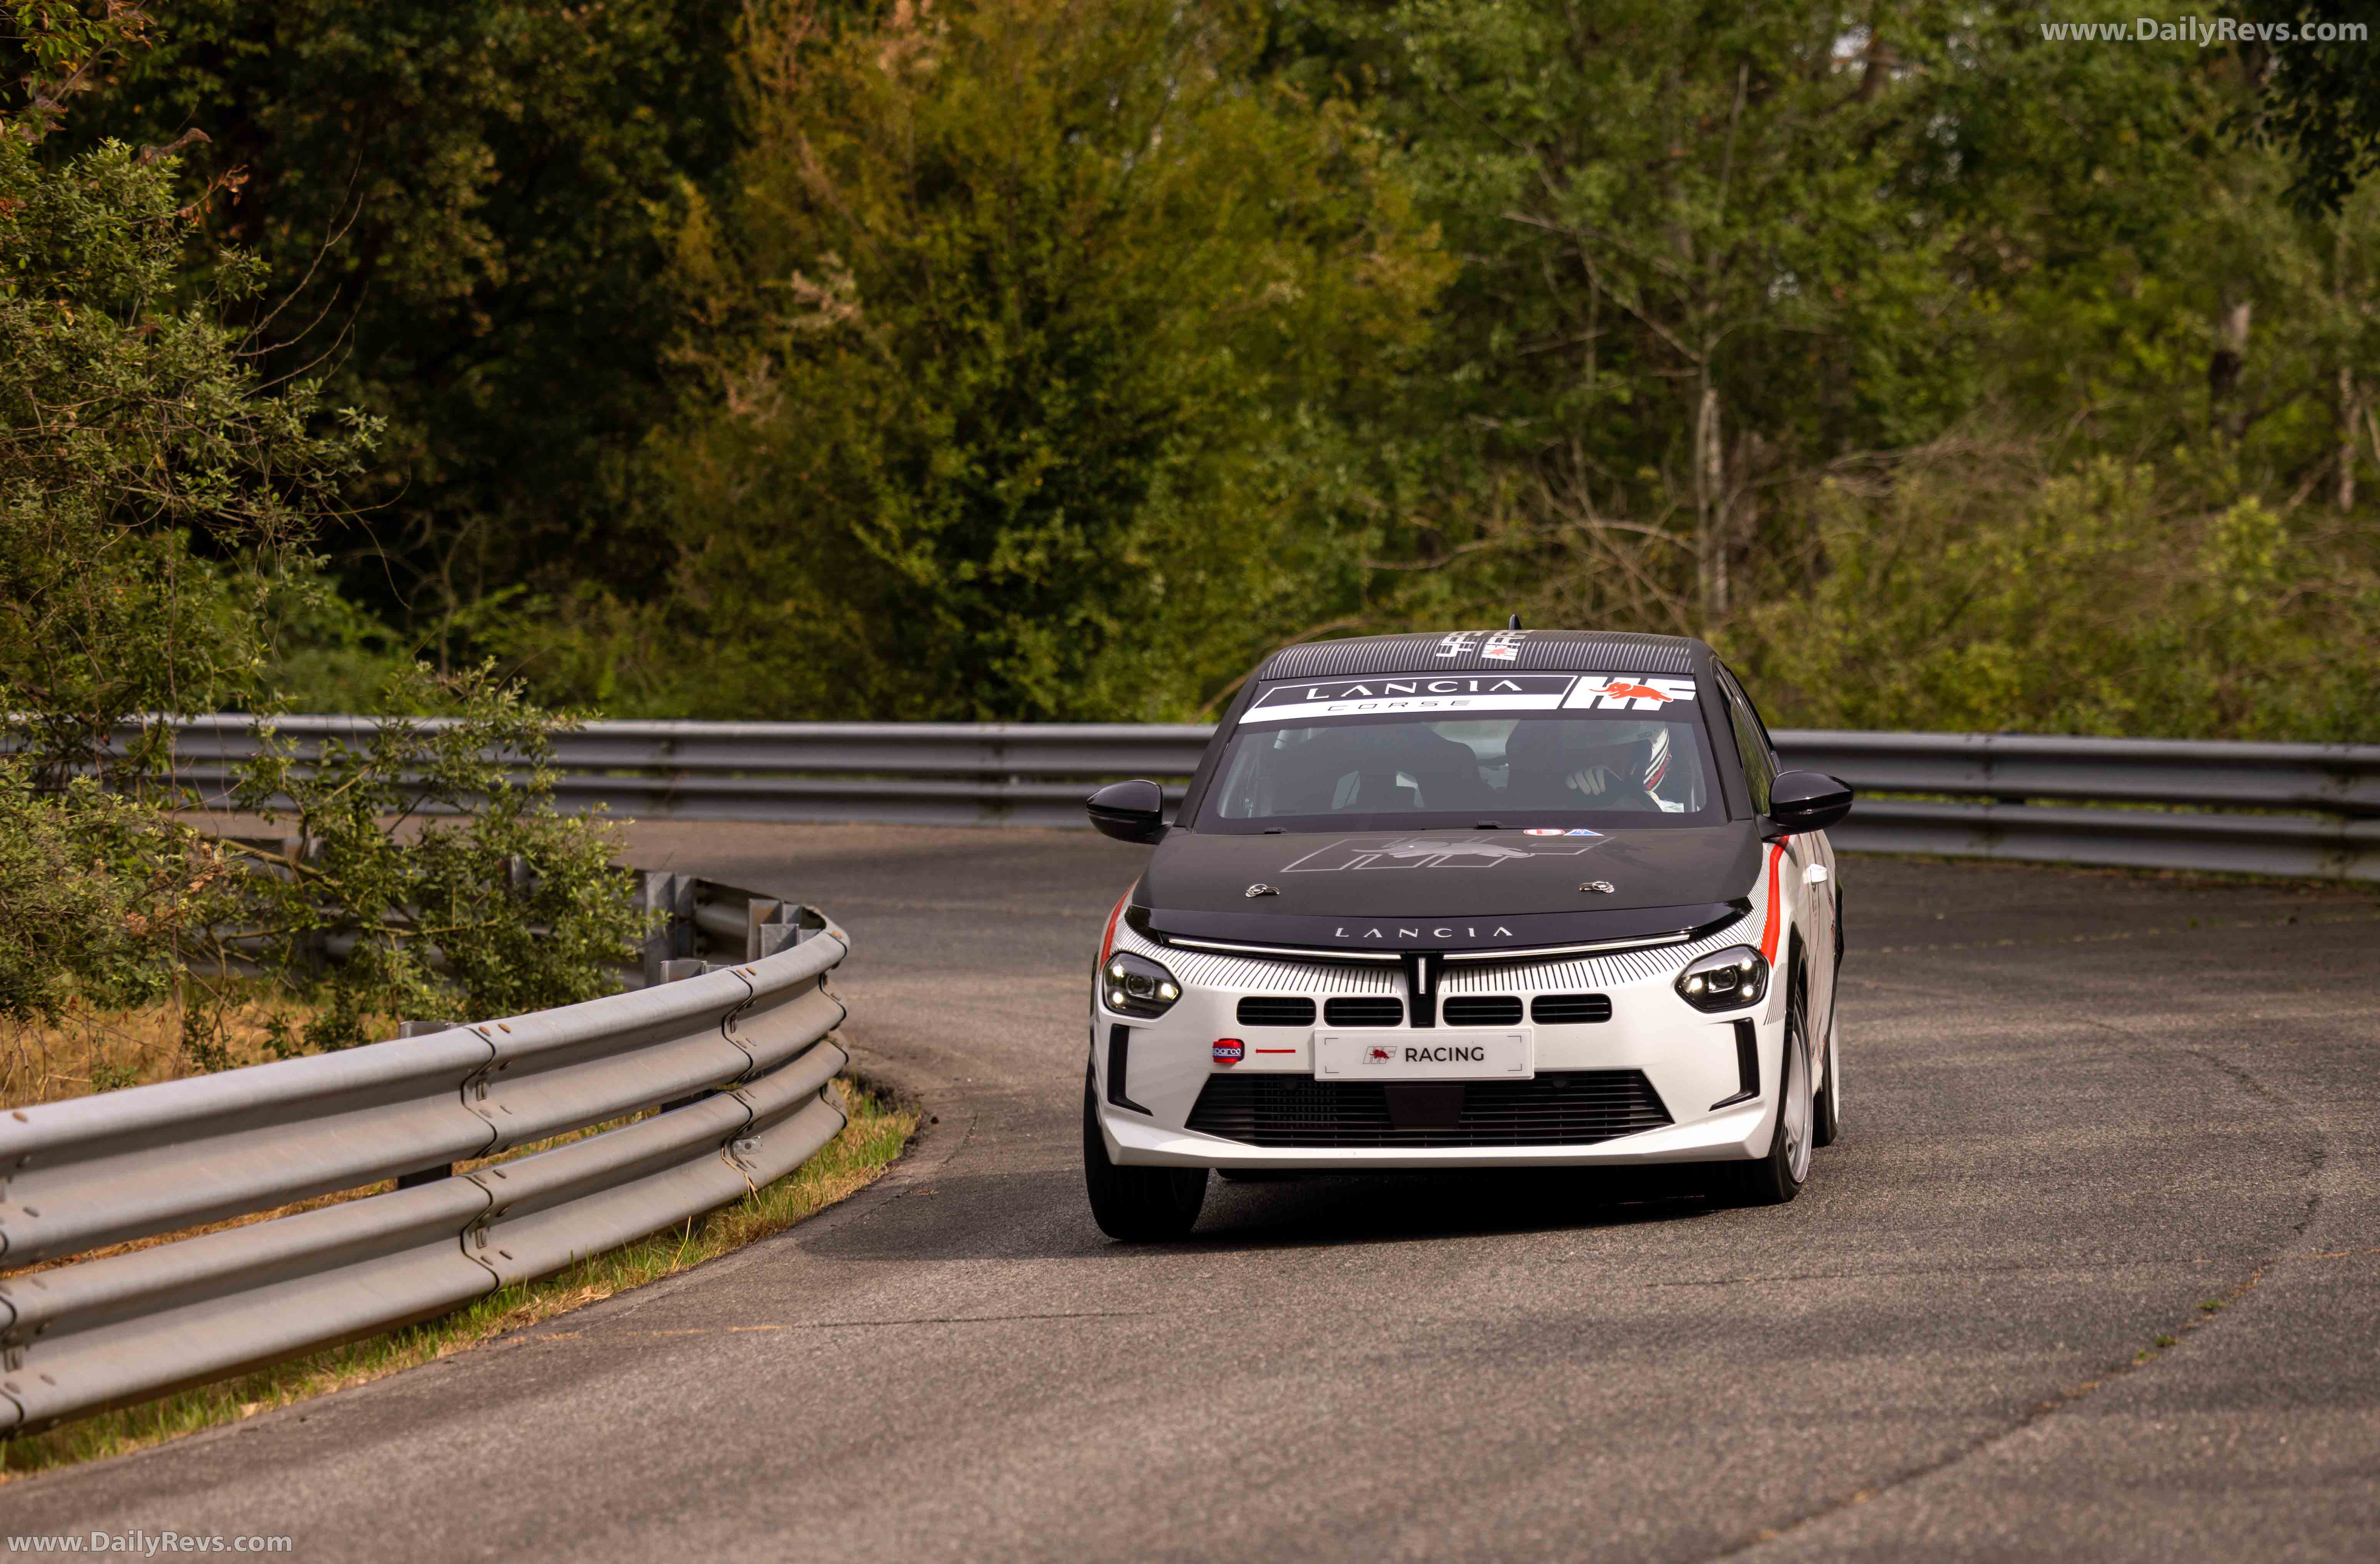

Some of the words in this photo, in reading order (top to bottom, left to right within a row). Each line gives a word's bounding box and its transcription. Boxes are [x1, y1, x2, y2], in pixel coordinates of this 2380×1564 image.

[1306, 680, 1522, 700] LANCIA
[1327, 700, 1471, 711] CORSE
[1335, 927, 1513, 938] LANCIA
[1405, 1047, 1484, 1062] RACING
